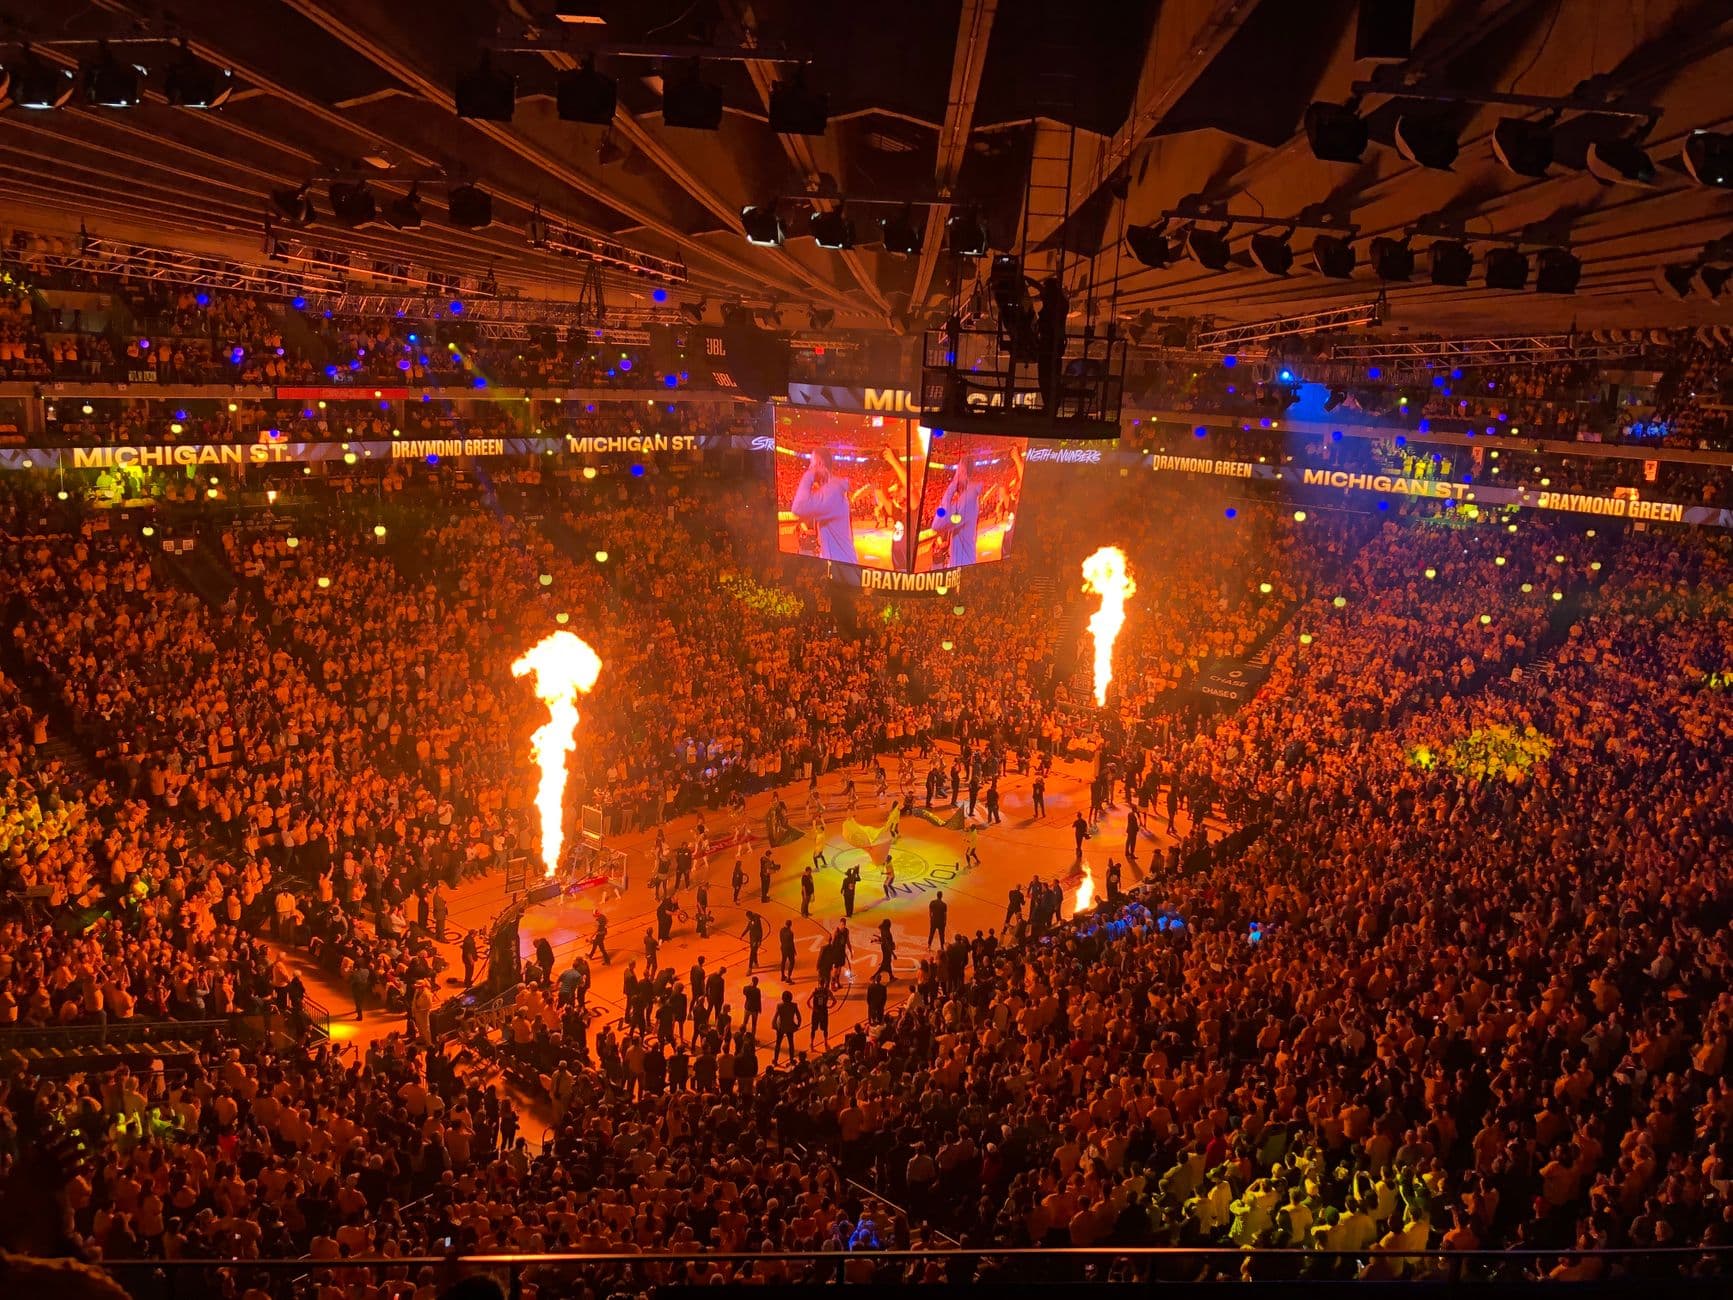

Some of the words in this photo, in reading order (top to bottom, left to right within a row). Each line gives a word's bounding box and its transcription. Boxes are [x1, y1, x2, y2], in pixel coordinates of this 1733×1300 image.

[706, 338, 726, 356] JBL
[712, 372, 738, 388] JBL
[392, 440, 462, 458] DRAYMOND
[465, 439, 504, 456] GREEN
[570, 436, 668, 453] MICHIGAN
[672, 435, 698, 451] ST.
[74, 444, 243, 467] MICHIGAN
[250, 444, 292, 463] ST.
[1153, 454, 1212, 474] DRAYMOND
[1215, 461, 1253, 478] GREEN
[1303, 469, 1428, 496] MICHIGAN
[1540, 492, 1626, 517] DRAYMOND
[1629, 501, 1683, 522] GREEN
[861, 569, 943, 591] DRAYMOND
[1209, 675, 1249, 688] CHASE
[1202, 686, 1231, 698] CHASE
